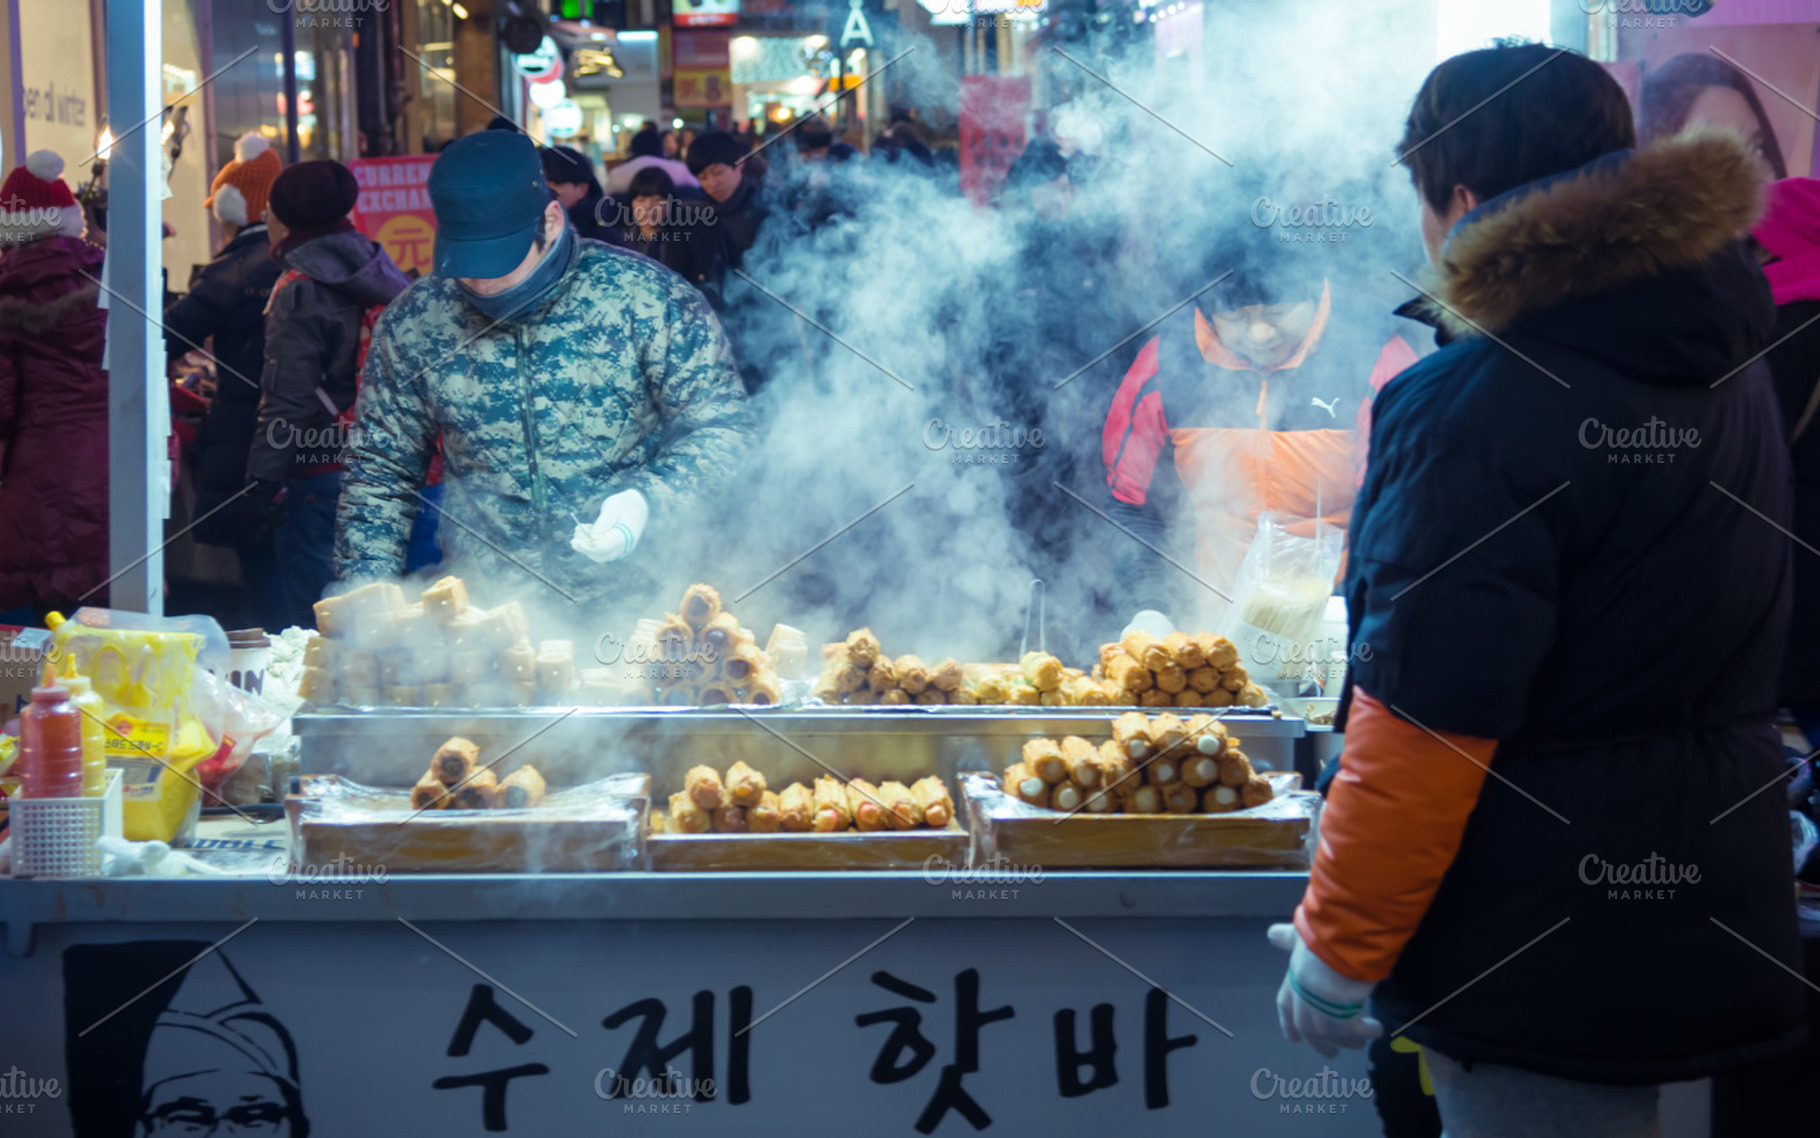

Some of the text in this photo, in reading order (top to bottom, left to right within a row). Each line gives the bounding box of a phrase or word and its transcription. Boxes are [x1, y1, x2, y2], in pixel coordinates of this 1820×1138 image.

[353, 163, 430, 187] CURREN
[358, 189, 434, 213] EXCHAN
[388, 228, 430, 266] 元
[432, 966, 1198, 1136] 수제 핫바
